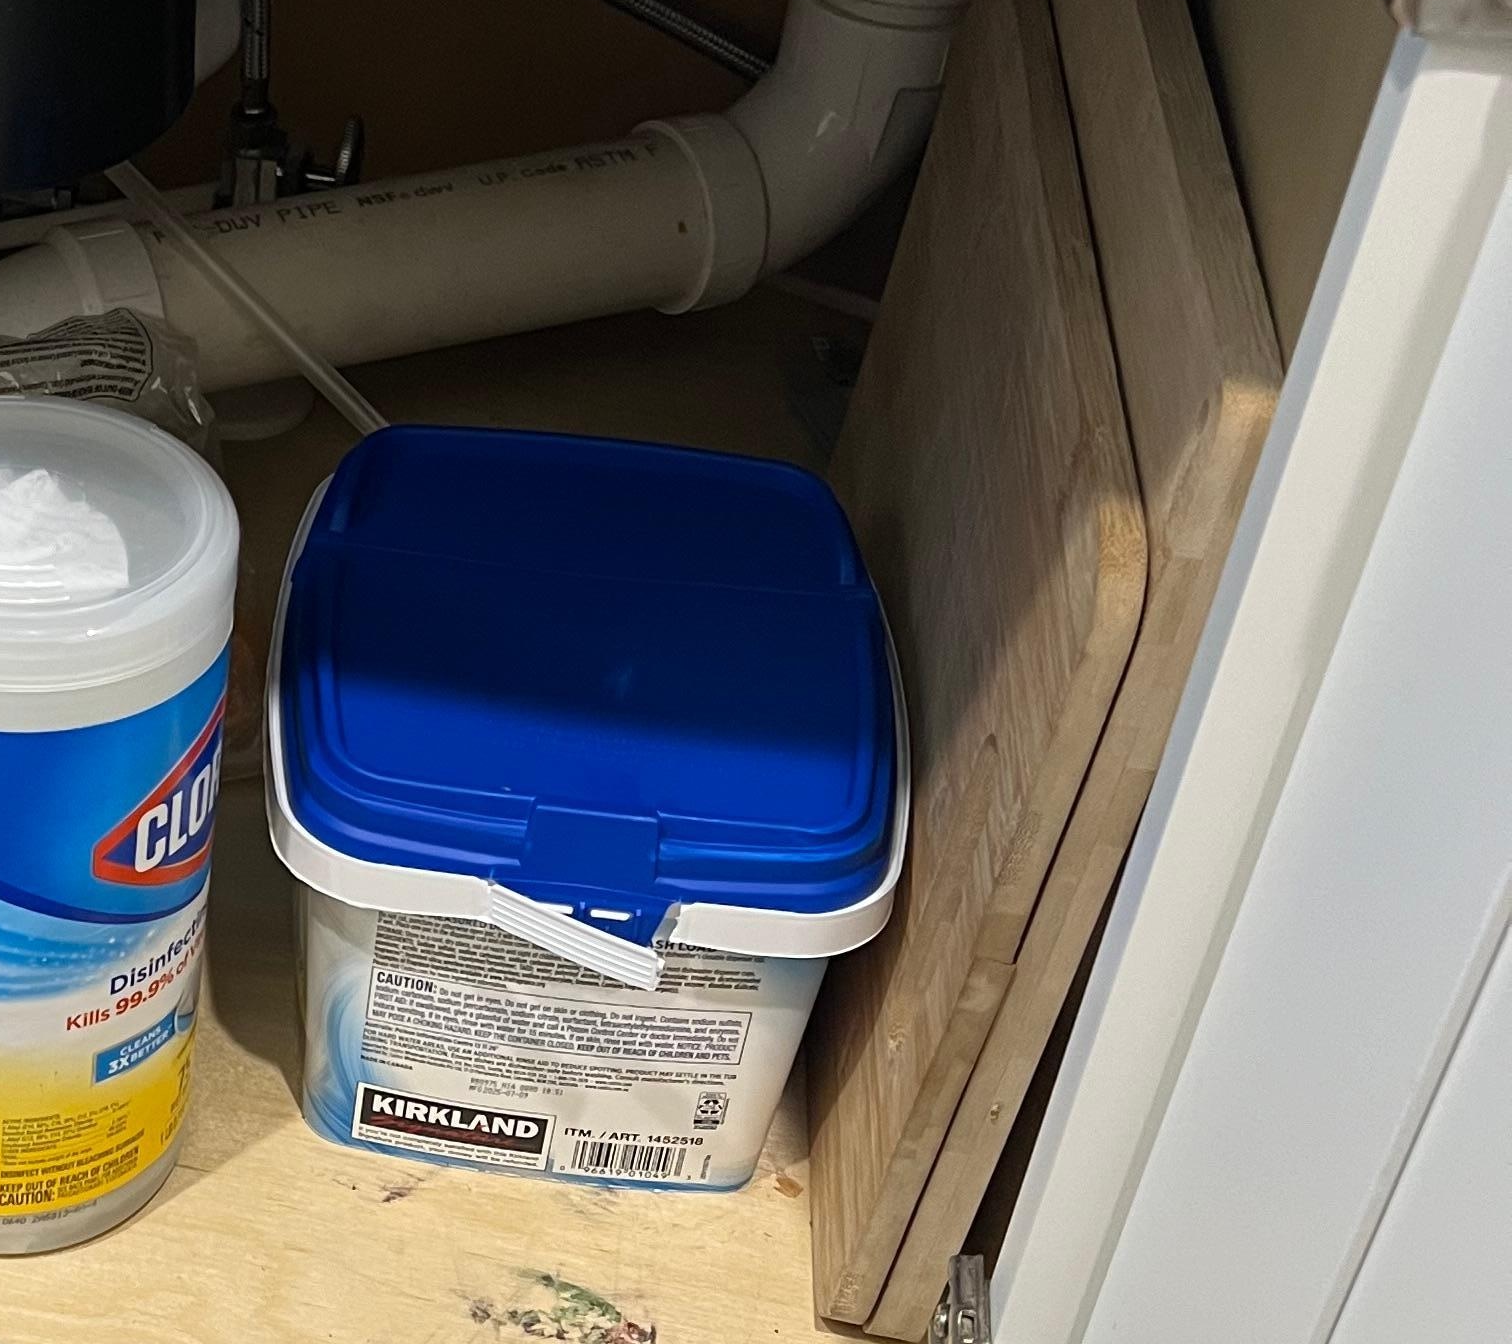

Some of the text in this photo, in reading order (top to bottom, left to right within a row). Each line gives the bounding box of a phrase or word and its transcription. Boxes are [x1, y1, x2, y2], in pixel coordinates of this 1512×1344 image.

[276, 201, 342, 224] PIPE
[376, 972, 439, 994] CAUTION:
[66, 1006, 110, 1032] Kills
[115, 971, 175, 1016] 99.9%
[107, 1030, 170, 1076] 3X BETTER
[119, 1026, 162, 1058] CLEANS
[576, 1043, 596, 1053] KEEP
[596, 1044, 611, 1054] OUT
[612, 1046, 622, 1054] OF
[622, 1047, 647, 1056] REACH
[648, 1048, 658, 1057] OF
[658, 1049, 694, 1060] CHILDREN
[694, 1052, 711, 1061] AND
[372, 1094, 540, 1139] KIRKLAND
[564, 1127, 595, 1139] ITM.
[608, 1132, 642, 1143] ART.
[647, 1135, 704, 1146] 1452518
[0, 1168, 40, 1179] DISINFECT
[40, 1161, 76, 1175] WITHOUT
[76, 1147, 115, 1168] BLEACHING
[0, 1145, 140, 1193] KEEP OUT OF REACH OF CHILDREN
[583, 1166, 622, 1176] 96619
[628, 1168, 669, 1180] 01049
